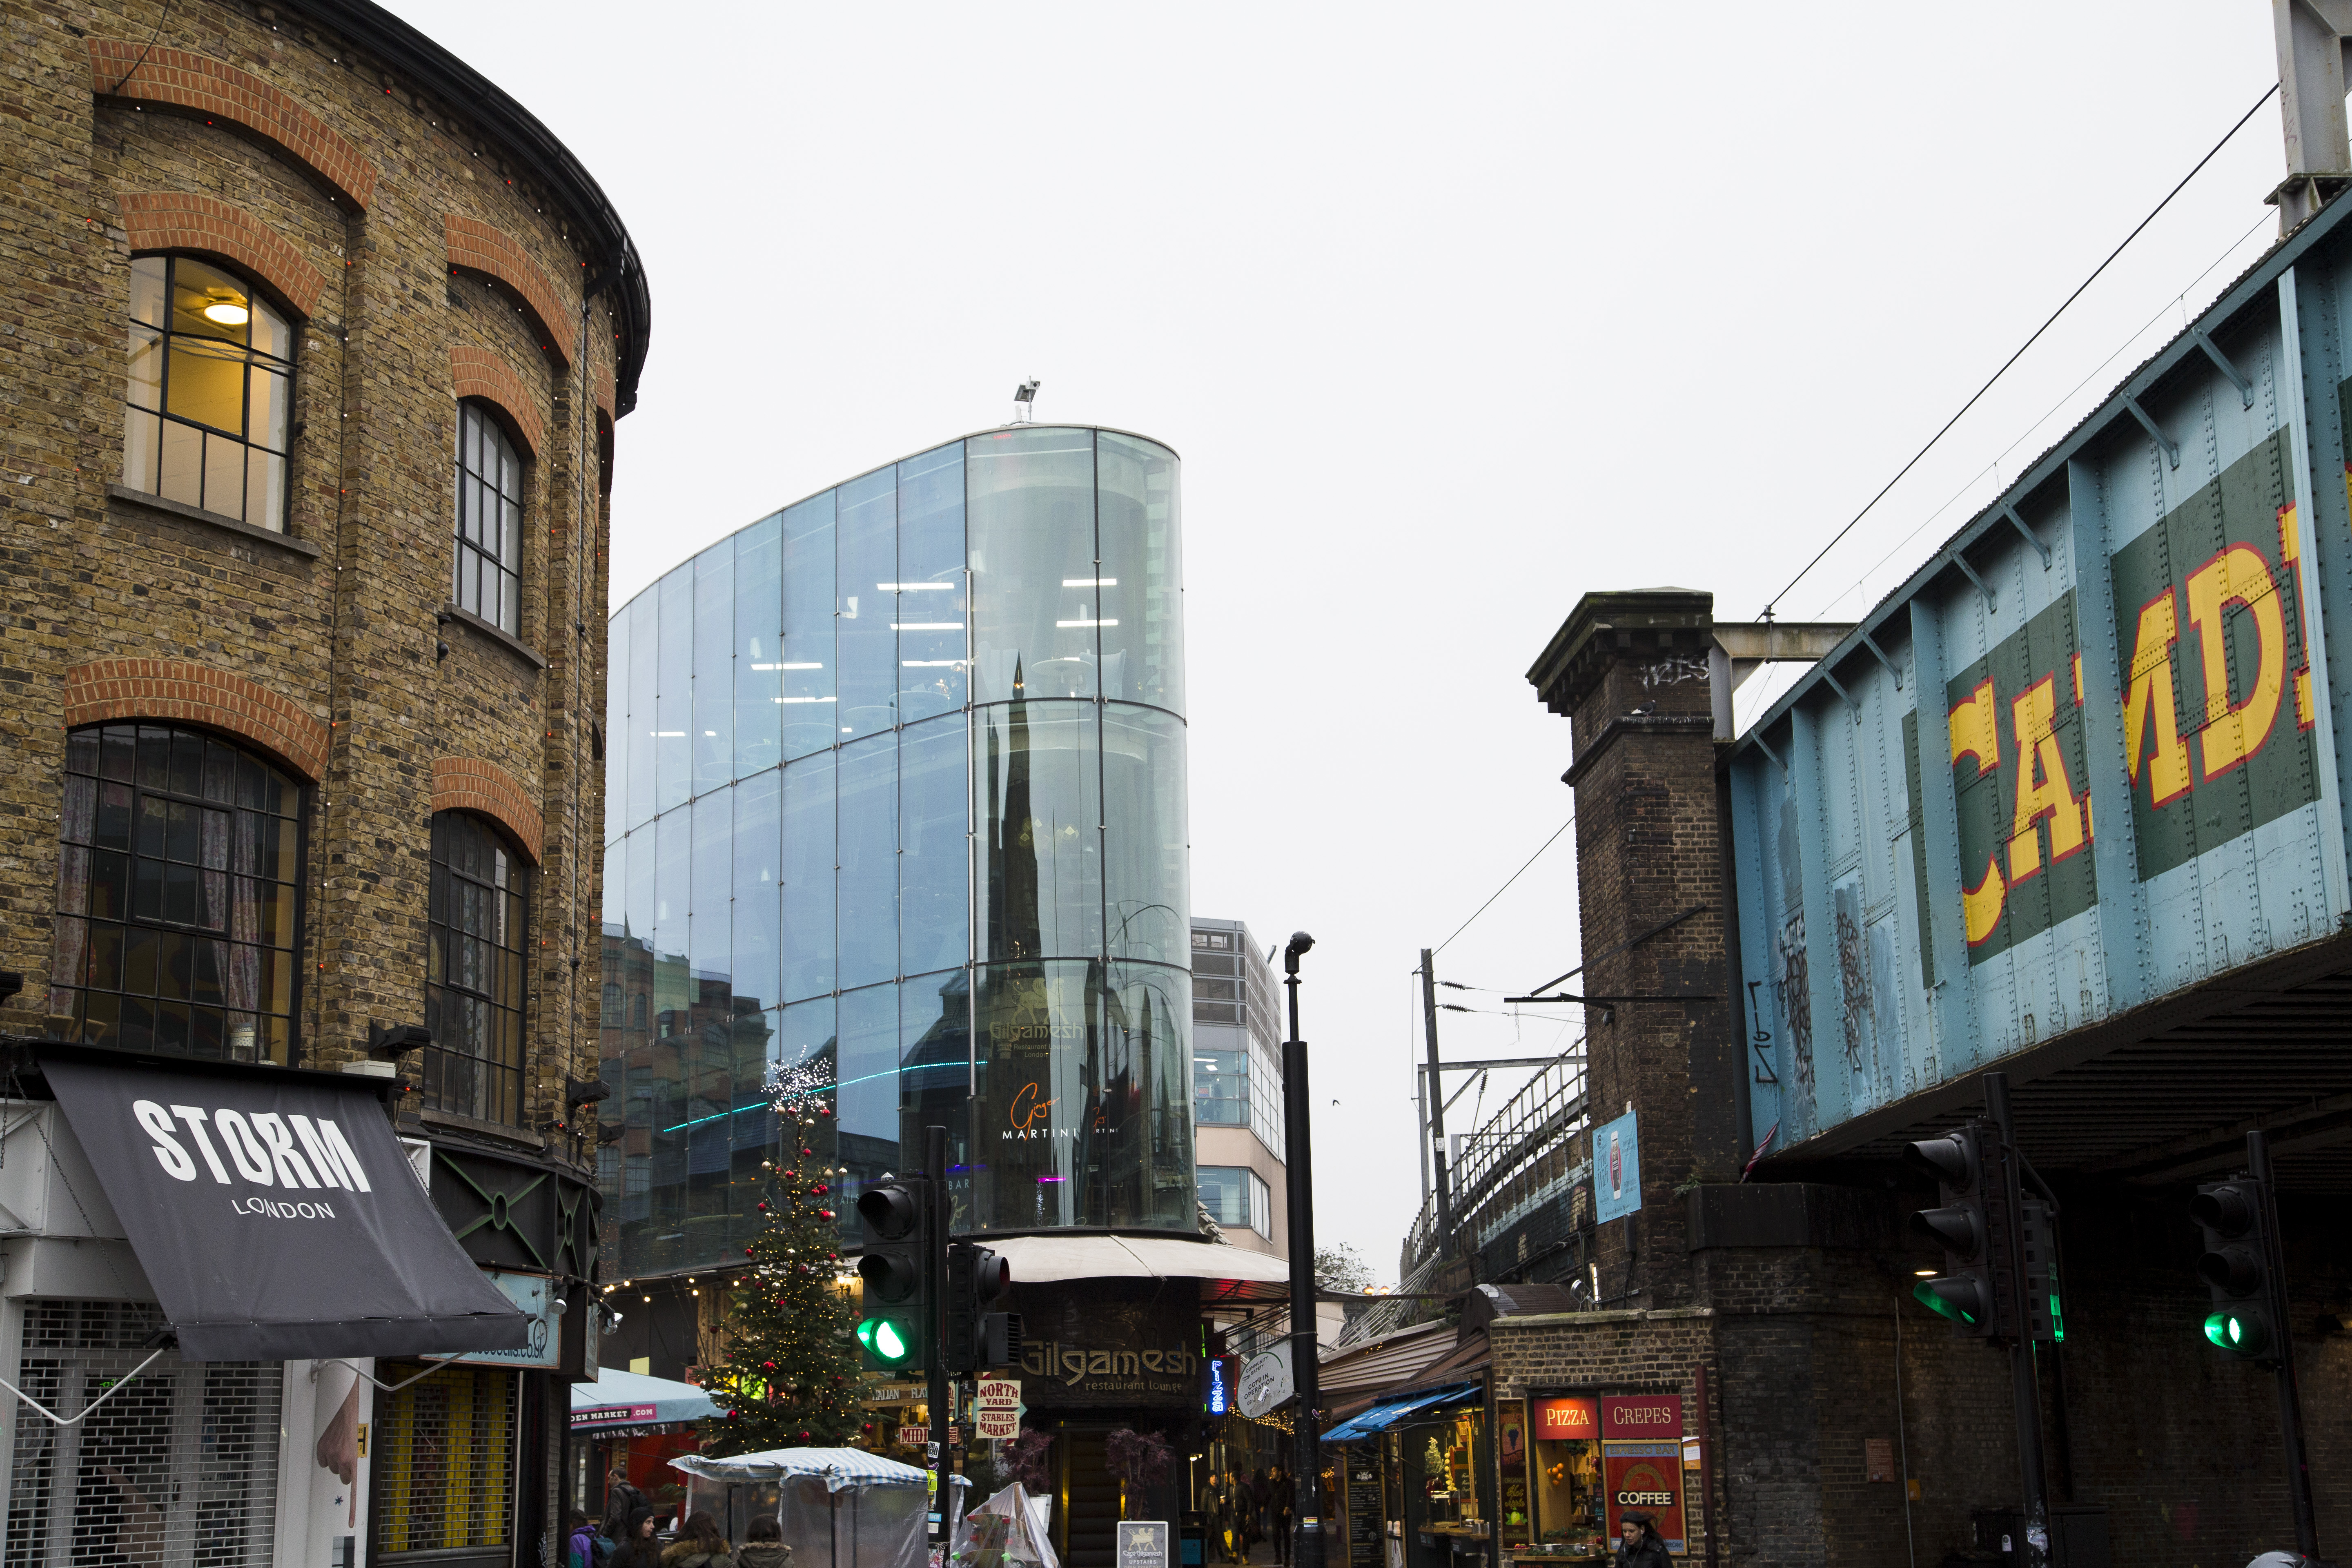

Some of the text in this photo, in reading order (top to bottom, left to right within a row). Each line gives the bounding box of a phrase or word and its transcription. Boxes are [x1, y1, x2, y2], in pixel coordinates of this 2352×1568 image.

[1011, 1082, 1060, 1141] Ginger
[1002, 1128, 1076, 1139] MARTINI
[133, 1098, 372, 1193] STORM
[949, 1179, 969, 1190] BAR
[230, 1196, 336, 1219] LONDON
[811, 1193, 860, 1207] COCKAILS
[1021, 1341, 1196, 1386] Gilgamesh
[1246, 1356, 1268, 1373] COMMUNITY
[1251, 1363, 1264, 1376] SAFETY
[1086, 1380, 1182, 1392] restaurant lounge
[1212, 1360, 1224, 1412] Pizza
[1244, 1376, 1275, 1400] OPERATION
[1248, 1372, 1269, 1390] CCTV IN
[980, 1383, 1018, 1398] NORTH
[571, 1408, 653, 1422] DEN MARKET .COM
[981, 1413, 1015, 1422] STABLES
[1546, 1409, 1590, 1426] PIZZA
[1614, 1406, 1671, 1425] CREPES
[979, 1421, 1017, 1436] MARKET
[1609, 1446, 1653, 1455] ESPRESSO
[1655, 1446, 1676, 1454] BAR
[1506, 1484, 1524, 1497] Hot
[1618, 1492, 1671, 1505] COFFEE
